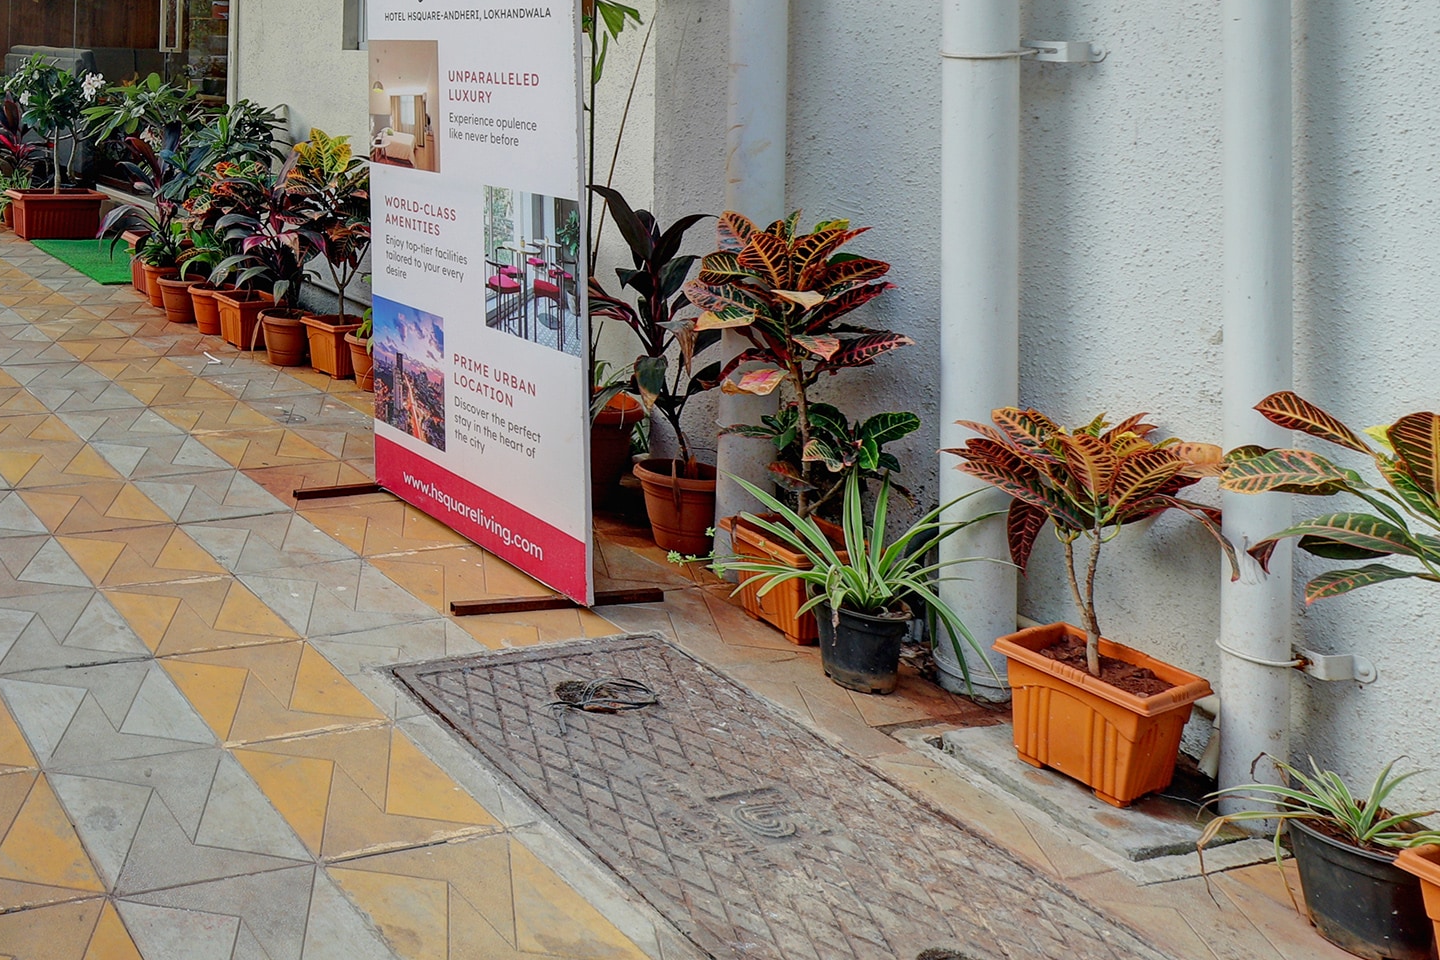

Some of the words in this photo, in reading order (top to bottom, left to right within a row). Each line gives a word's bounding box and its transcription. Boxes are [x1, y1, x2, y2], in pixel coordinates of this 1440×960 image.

[384, 11, 406, 22] HOTEL
[407, 9, 482, 22] HSQUARE-ANDHERI,
[483, 7, 552, 20] LOKHANDWALA
[448, 70, 540, 87] UNPARALLELED
[448, 89, 493, 104] LUXURY
[449, 112, 494, 128] Experience
[496, 117, 538, 132] opulence
[448, 128, 463, 141] like
[464, 132, 488, 143] never
[490, 133, 520, 147] before
[384, 195, 457, 222] WORLD-CLASS
[385, 213, 441, 236] AMENITIES
[385, 234, 404, 251] Enjoy
[405, 240, 433, 257] top-tier
[434, 246, 468, 266] facilities
[385, 250, 413, 266] tailored
[413, 257, 422, 269] to
[423, 260, 440, 275] your
[441, 265, 465, 283] every
[385, 265, 408, 280] desire
[453, 353, 489, 379] PRIME
[494, 369, 537, 398] URBAN
[453, 372, 514, 408] LOCATION
[454, 395, 490, 420] Discover
[491, 411, 506, 428] the
[507, 419, 542, 444] perfect
[454, 413, 472, 432] stay
[473, 419, 482, 434] in
[483, 423, 498, 441] the
[499, 430, 524, 454] heart
[526, 446, 537, 459] of
[454, 428, 468, 444] the
[469, 435, 486, 454] city
[402, 470, 544, 561] www.hsquareliving.com
